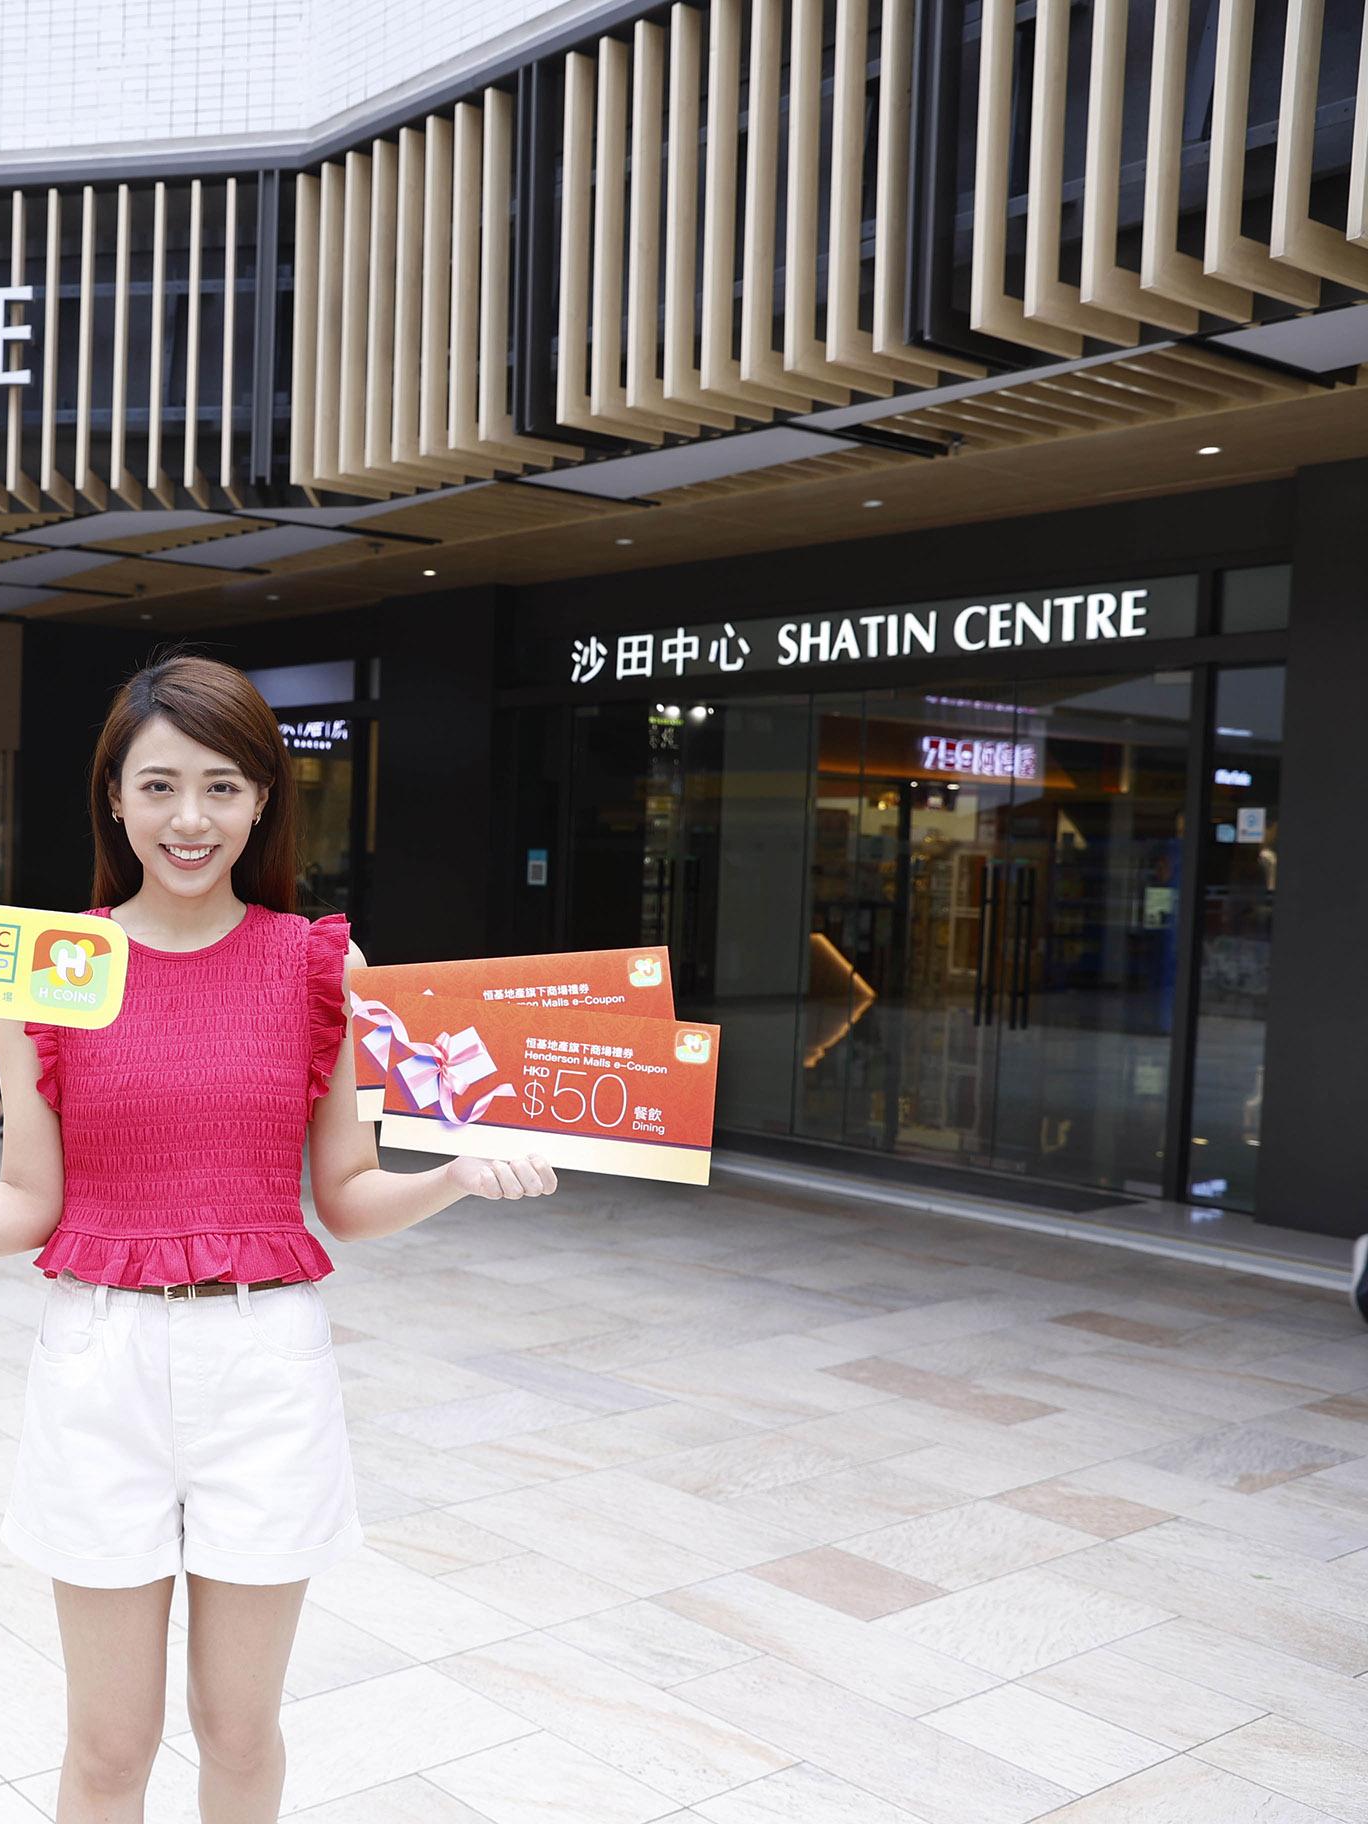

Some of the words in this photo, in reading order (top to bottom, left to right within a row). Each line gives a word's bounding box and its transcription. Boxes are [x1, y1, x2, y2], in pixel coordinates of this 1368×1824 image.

[777, 610, 937, 667] SHATIN
[953, 588, 1148, 652] CENTRE
[570, 622, 751, 684] 沙田中心
[38, 987, 49, 998] H
[52, 987, 97, 1004] COINS
[572, 994, 626, 1006] e-Coupon
[524, 1050, 581, 1065] Henderson
[583, 1056, 611, 1068] Malls
[613, 1061, 668, 1074] e-Coupon
[523, 1066, 550, 1077] HKD
[521, 1068, 628, 1128] $50
[634, 1105, 662, 1122] 餐飲
[632, 1120, 666, 1135] Dining
